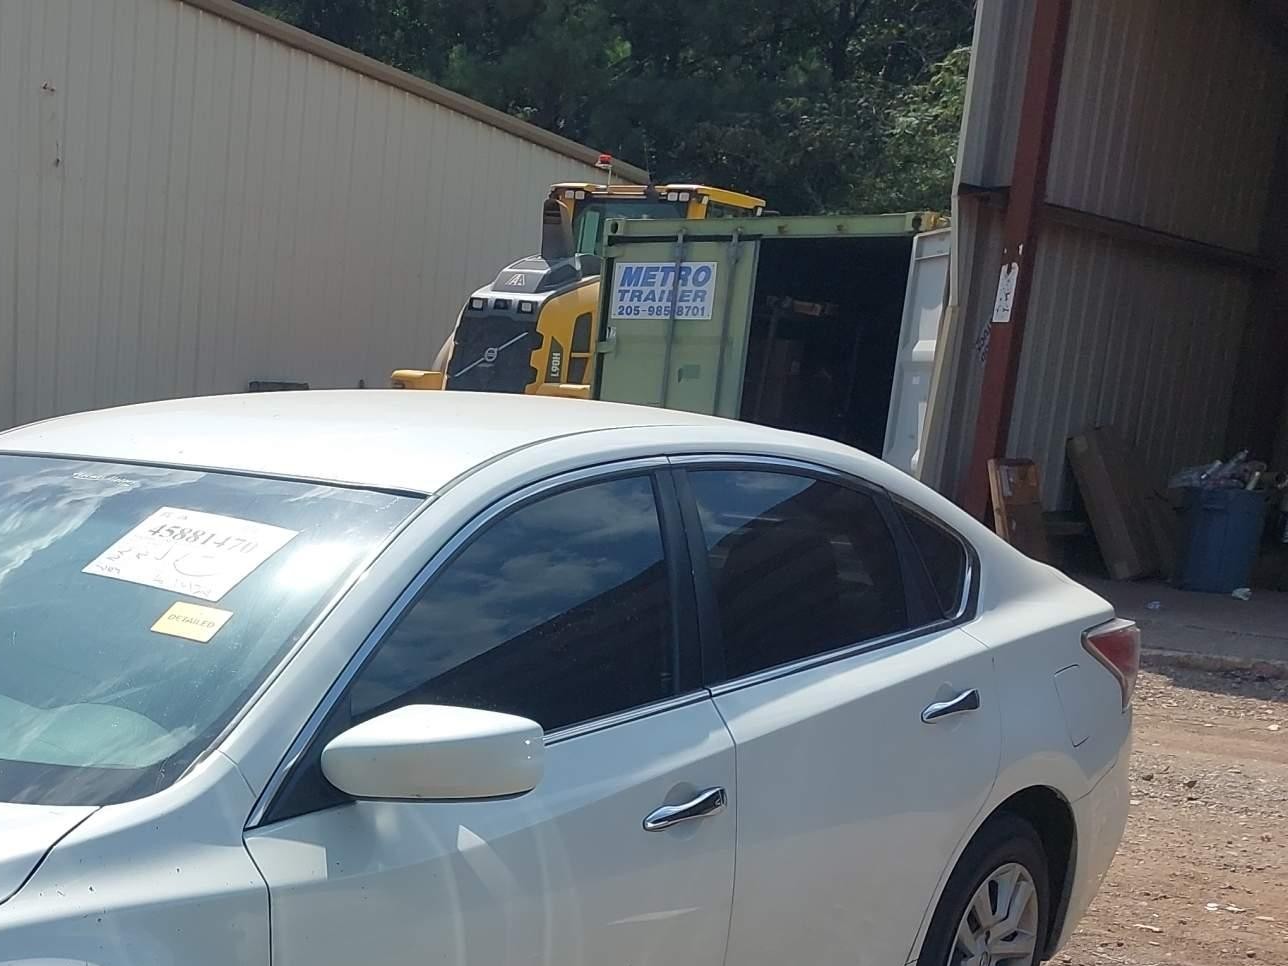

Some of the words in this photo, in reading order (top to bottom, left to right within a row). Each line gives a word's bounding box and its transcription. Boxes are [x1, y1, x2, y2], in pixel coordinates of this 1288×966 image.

[619, 265, 711, 287] METRO
[618, 289, 707, 303] TRAILER
[617, 305, 705, 317] 205-9858701
[148, 523, 259, 554] 45881470
[167, 614, 216, 628] DETAILED
